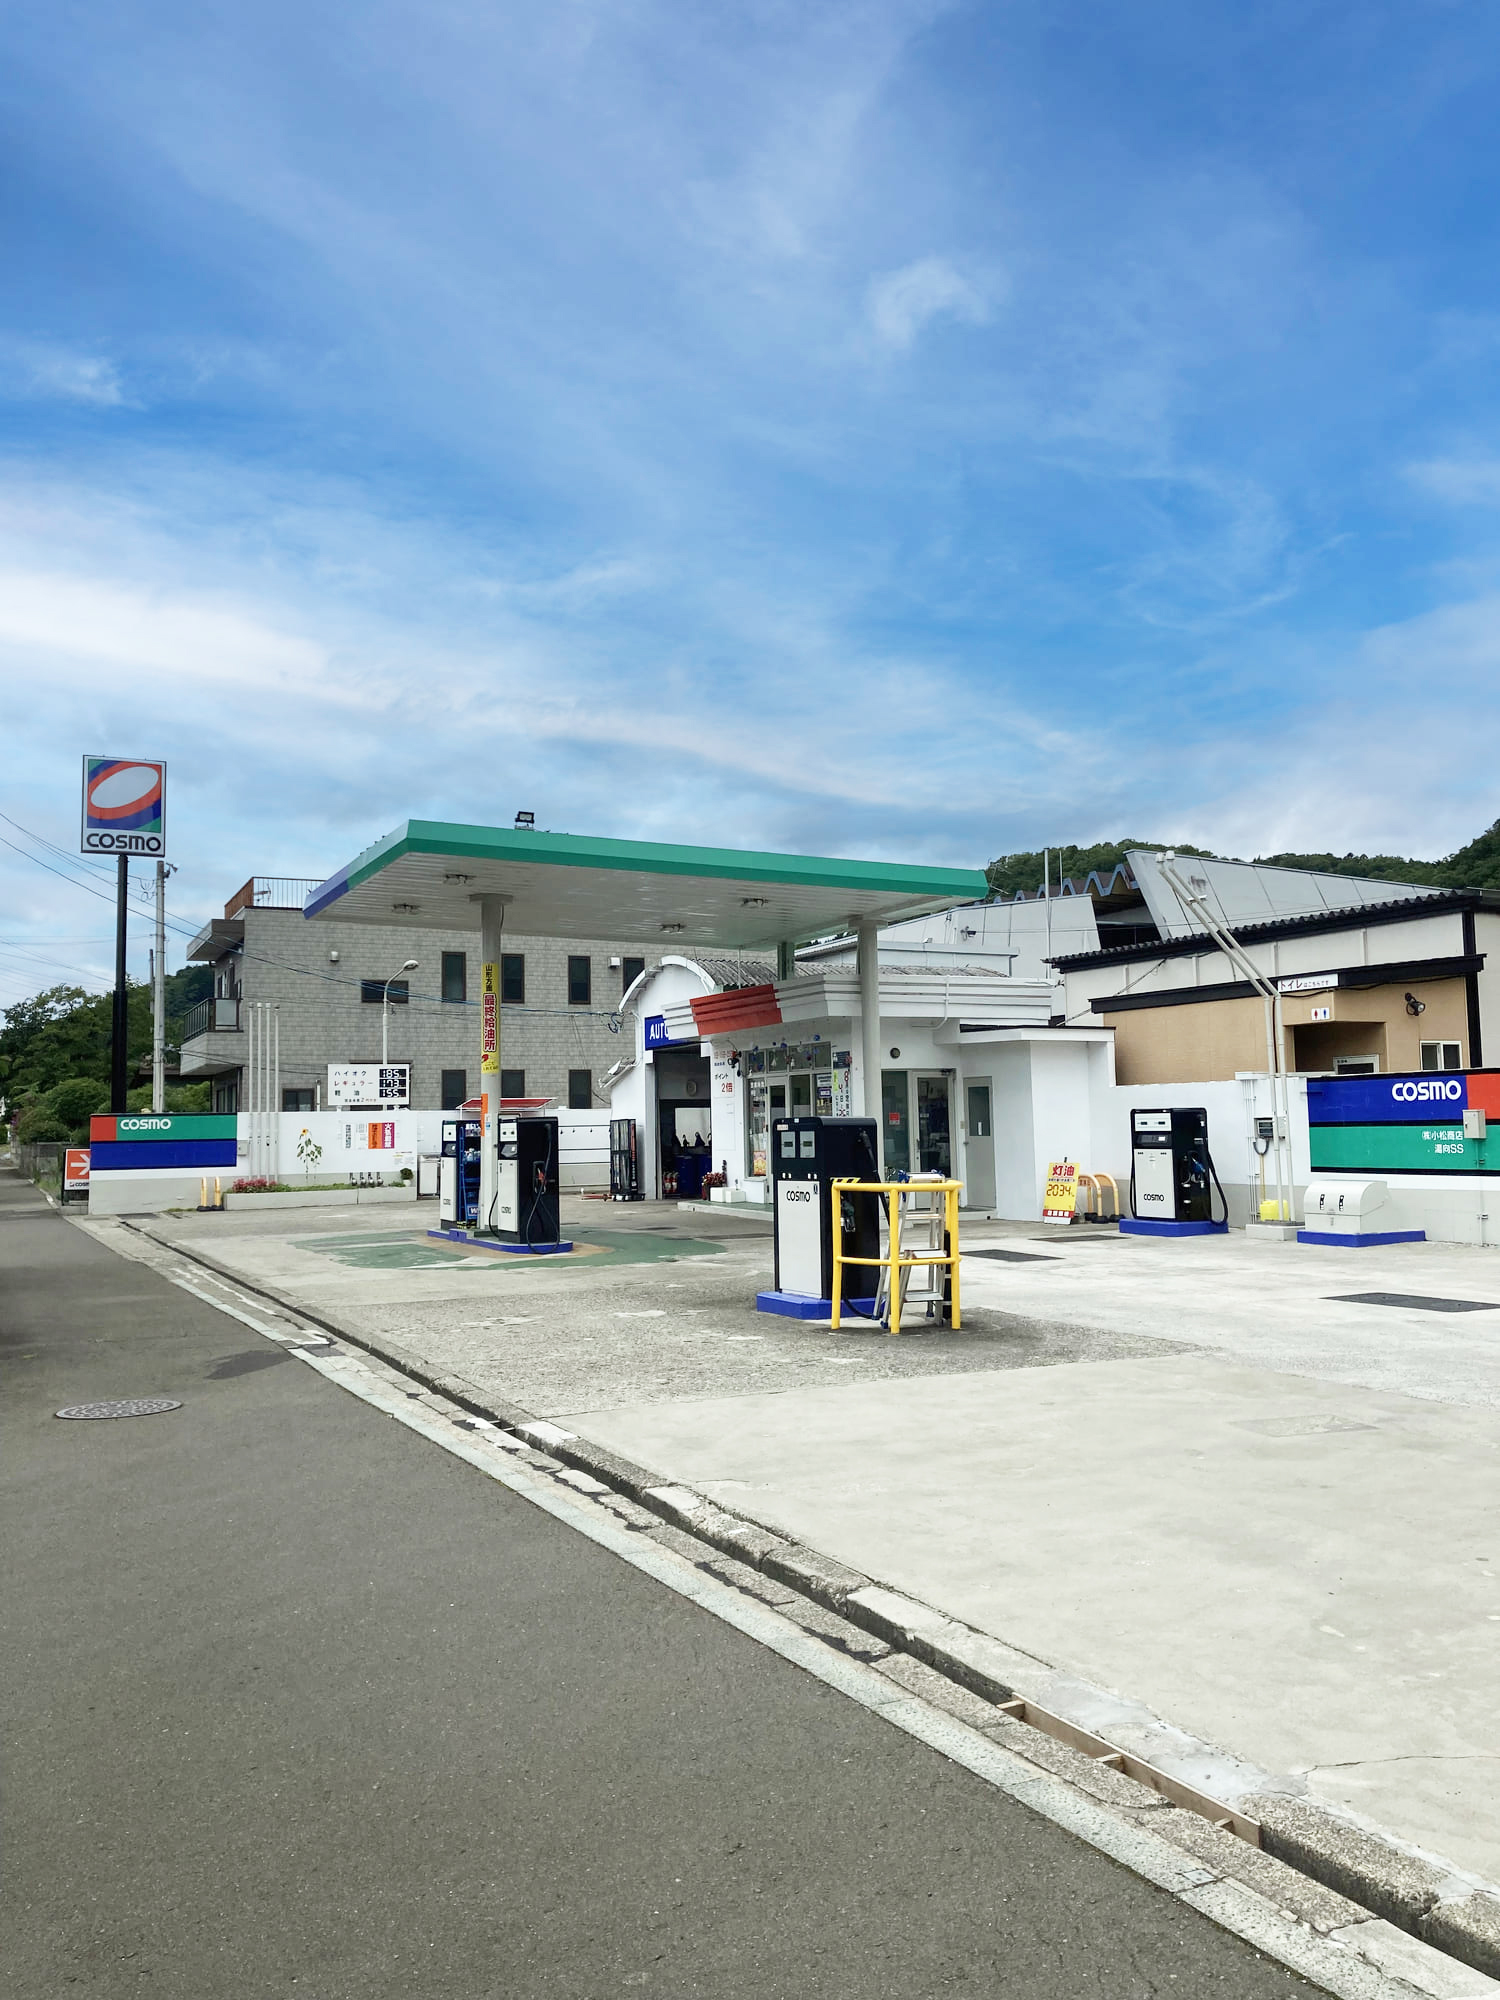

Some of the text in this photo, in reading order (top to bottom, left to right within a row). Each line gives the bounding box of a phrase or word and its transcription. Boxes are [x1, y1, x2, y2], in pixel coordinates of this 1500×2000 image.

[86, 833, 162, 852] COSMO
[382, 1069, 400, 1077] 185
[382, 1089, 400, 1097] 155
[721, 1082, 733, 1093] 2倍
[1392, 1080, 1462, 1101] COSMO
[120, 1119, 171, 1130] COSMO
[1052, 1165, 1075, 1177] 灯油
[786, 1190, 811, 1202] COSMO
[1046, 1184, 1071, 1197] 2034
[1143, 1193, 1165, 1202] COSMO
